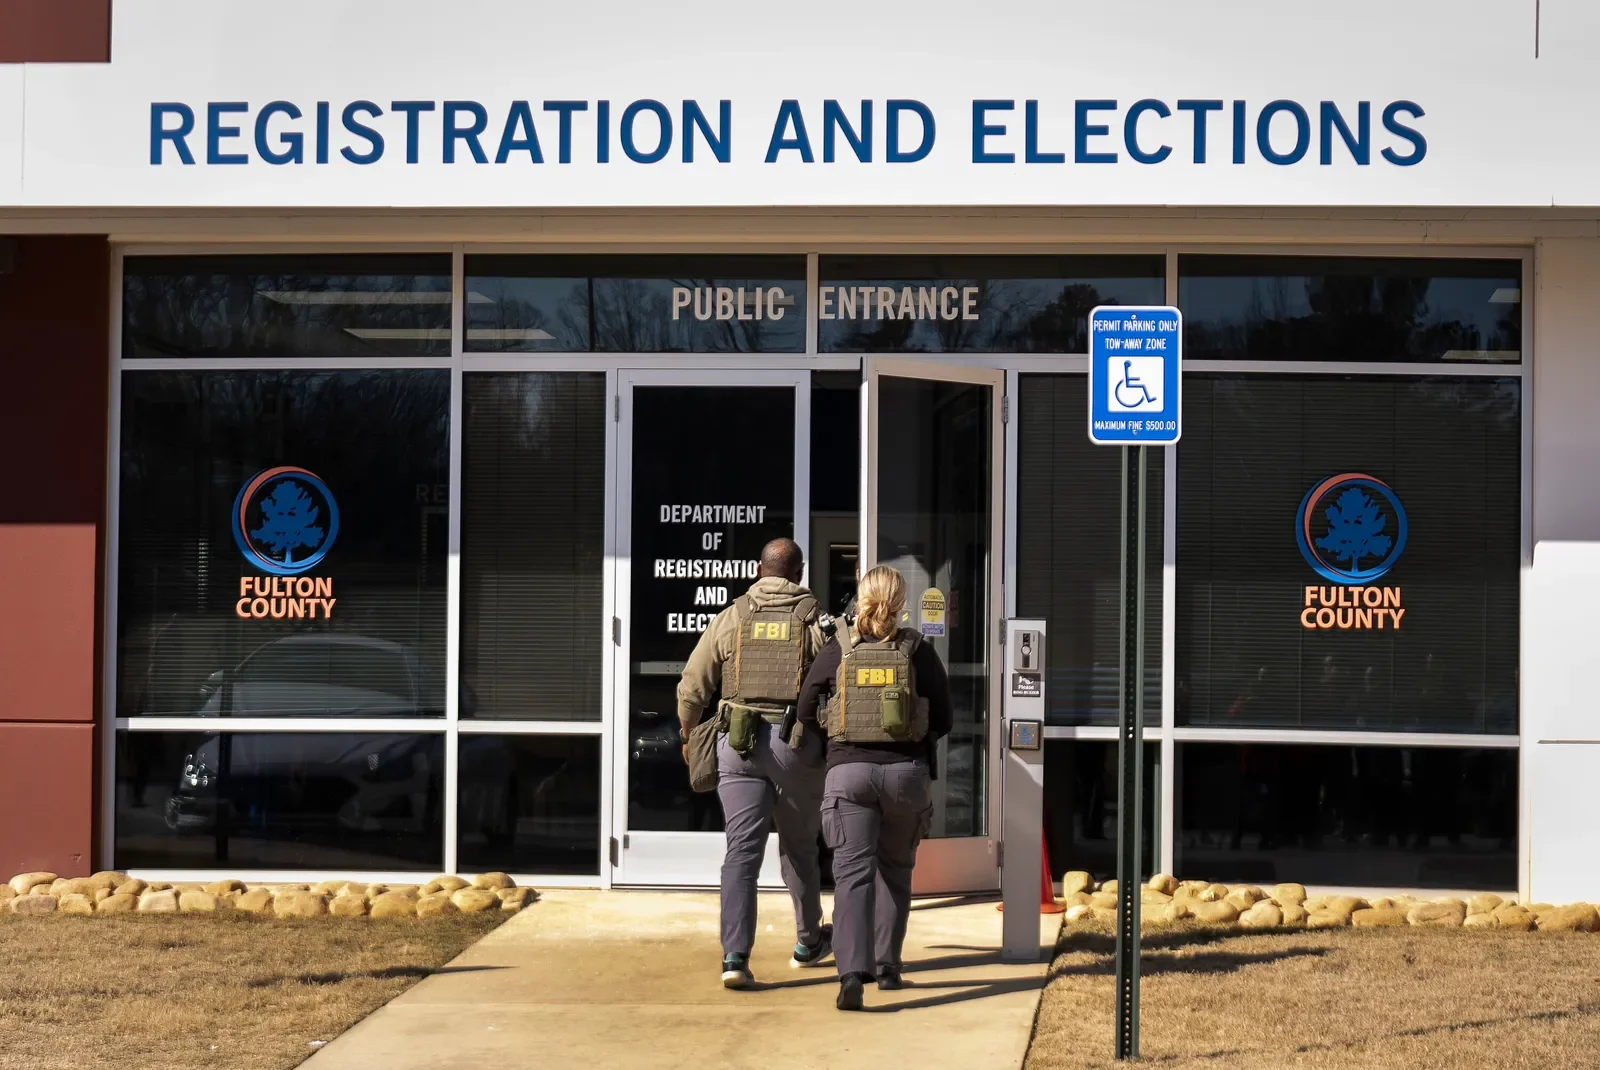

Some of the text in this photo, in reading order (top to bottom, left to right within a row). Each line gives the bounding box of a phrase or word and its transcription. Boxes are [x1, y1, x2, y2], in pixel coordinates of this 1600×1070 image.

[150, 99, 1426, 167] REGISTRATION AND ELECTIONS
[672, 285, 980, 322] PUBLIC ENTRANCE
[1093, 319, 1178, 332] PERMIT PARKING ONLY
[1145, 338, 1167, 350] ZONE
[1094, 420, 1176, 431] MAXIMUM FINE $500.00
[660, 504, 767, 524] DEPARTMENT
[702, 532, 723, 551] OF
[653, 558, 759, 580] REGISTRATIO
[240, 577, 332, 597] FULTON
[693, 586, 728, 606] AND
[1304, 585, 1401, 608] FULTON
[235, 598, 336, 619] COUNTY
[922, 601, 944, 609] CAUTION
[666, 612, 717, 633] ELECT
[1299, 607, 1406, 630] COUNTY
[753, 622, 788, 639] FBI
[857, 668, 895, 685] FBI
